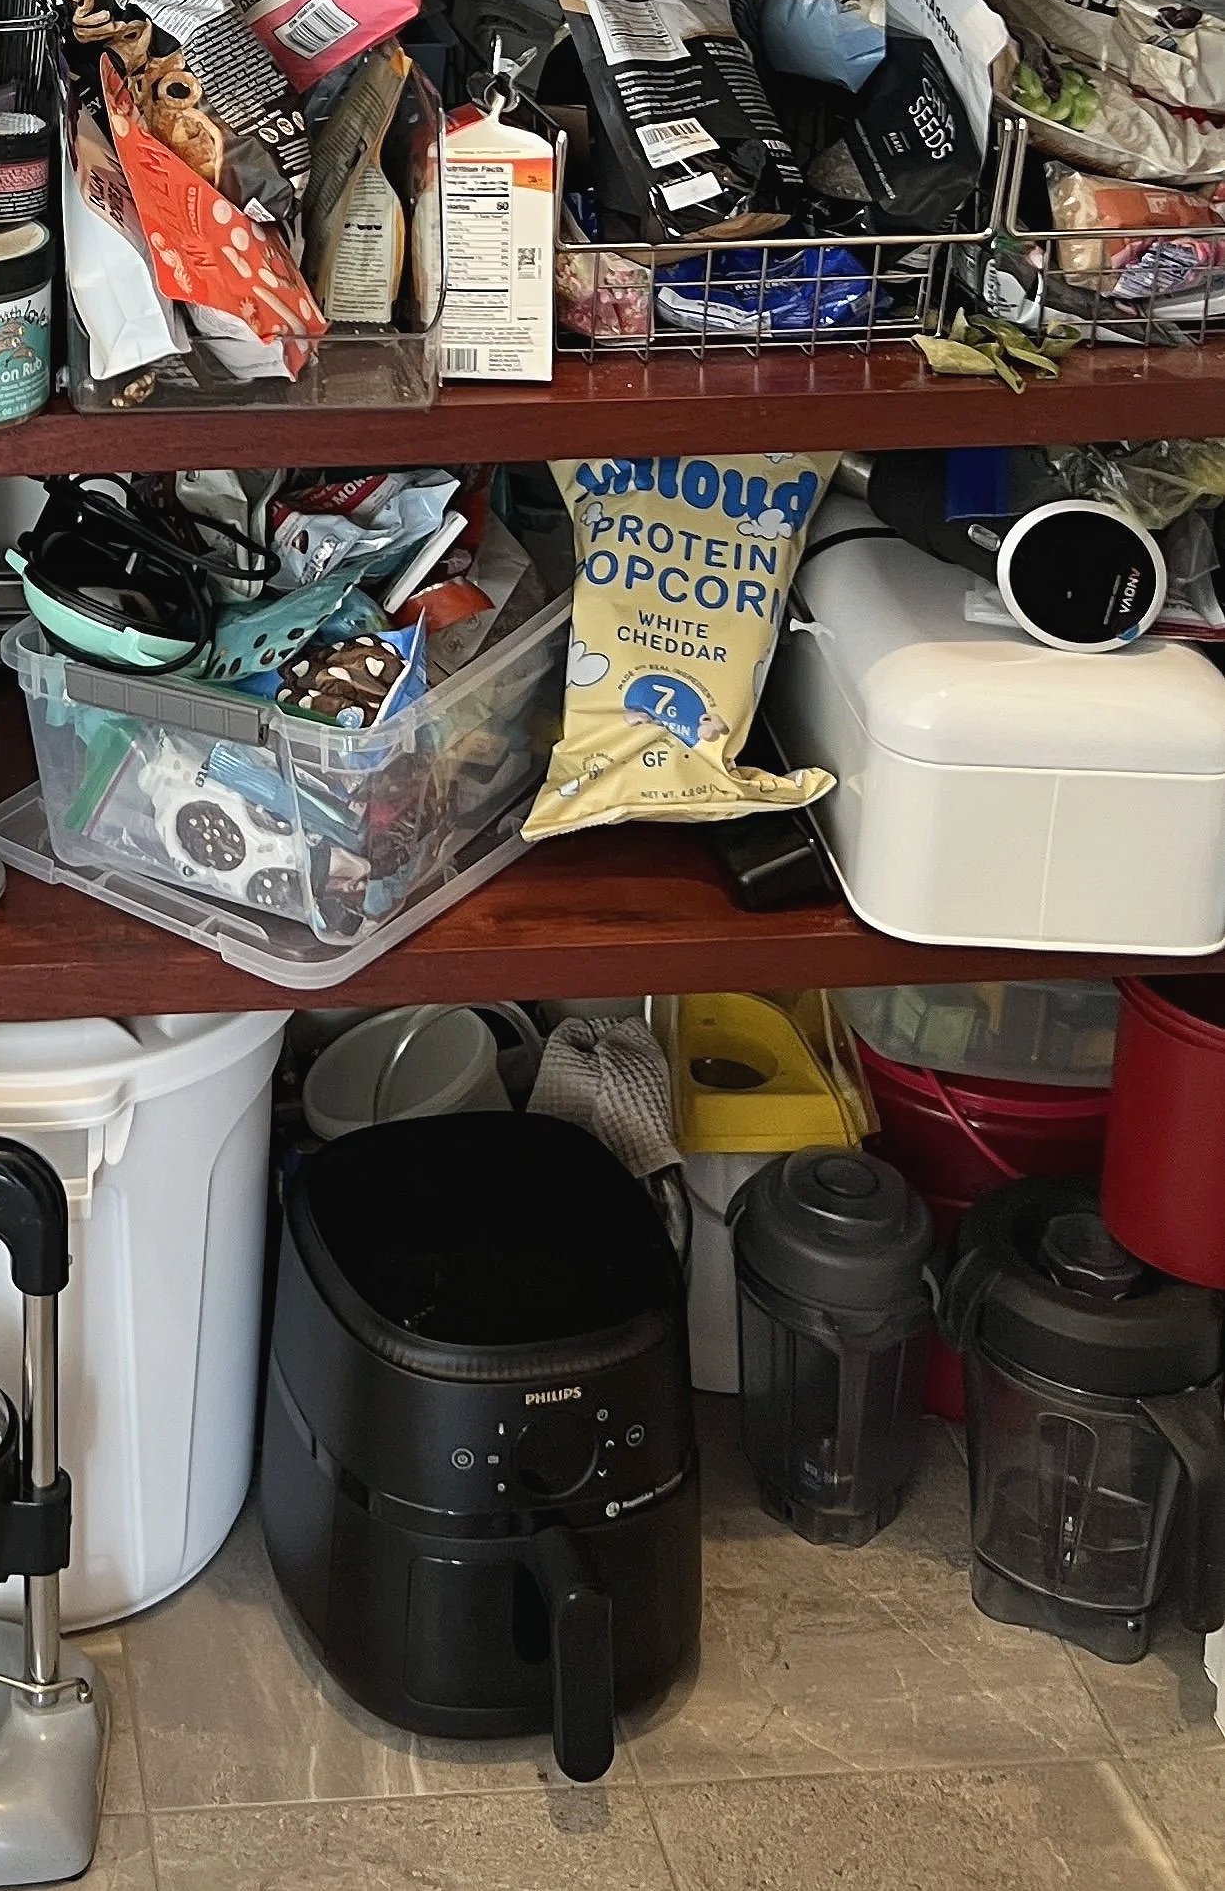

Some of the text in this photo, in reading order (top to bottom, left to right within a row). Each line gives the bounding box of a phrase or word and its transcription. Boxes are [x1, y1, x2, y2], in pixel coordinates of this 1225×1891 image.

[908, 97, 953, 161] SEEDS
[21, 359, 43, 377] Rub
[590, 514, 777, 575] PROTEIN
[1118, 567, 1142, 614] ANOVA
[638, 609, 710, 639] WHITE
[616, 625, 727, 663] CHEDDAR
[642, 749, 669, 768] GF
[641, 790, 659, 799] NET
[524, 1386, 583, 1405] PHILIPS
